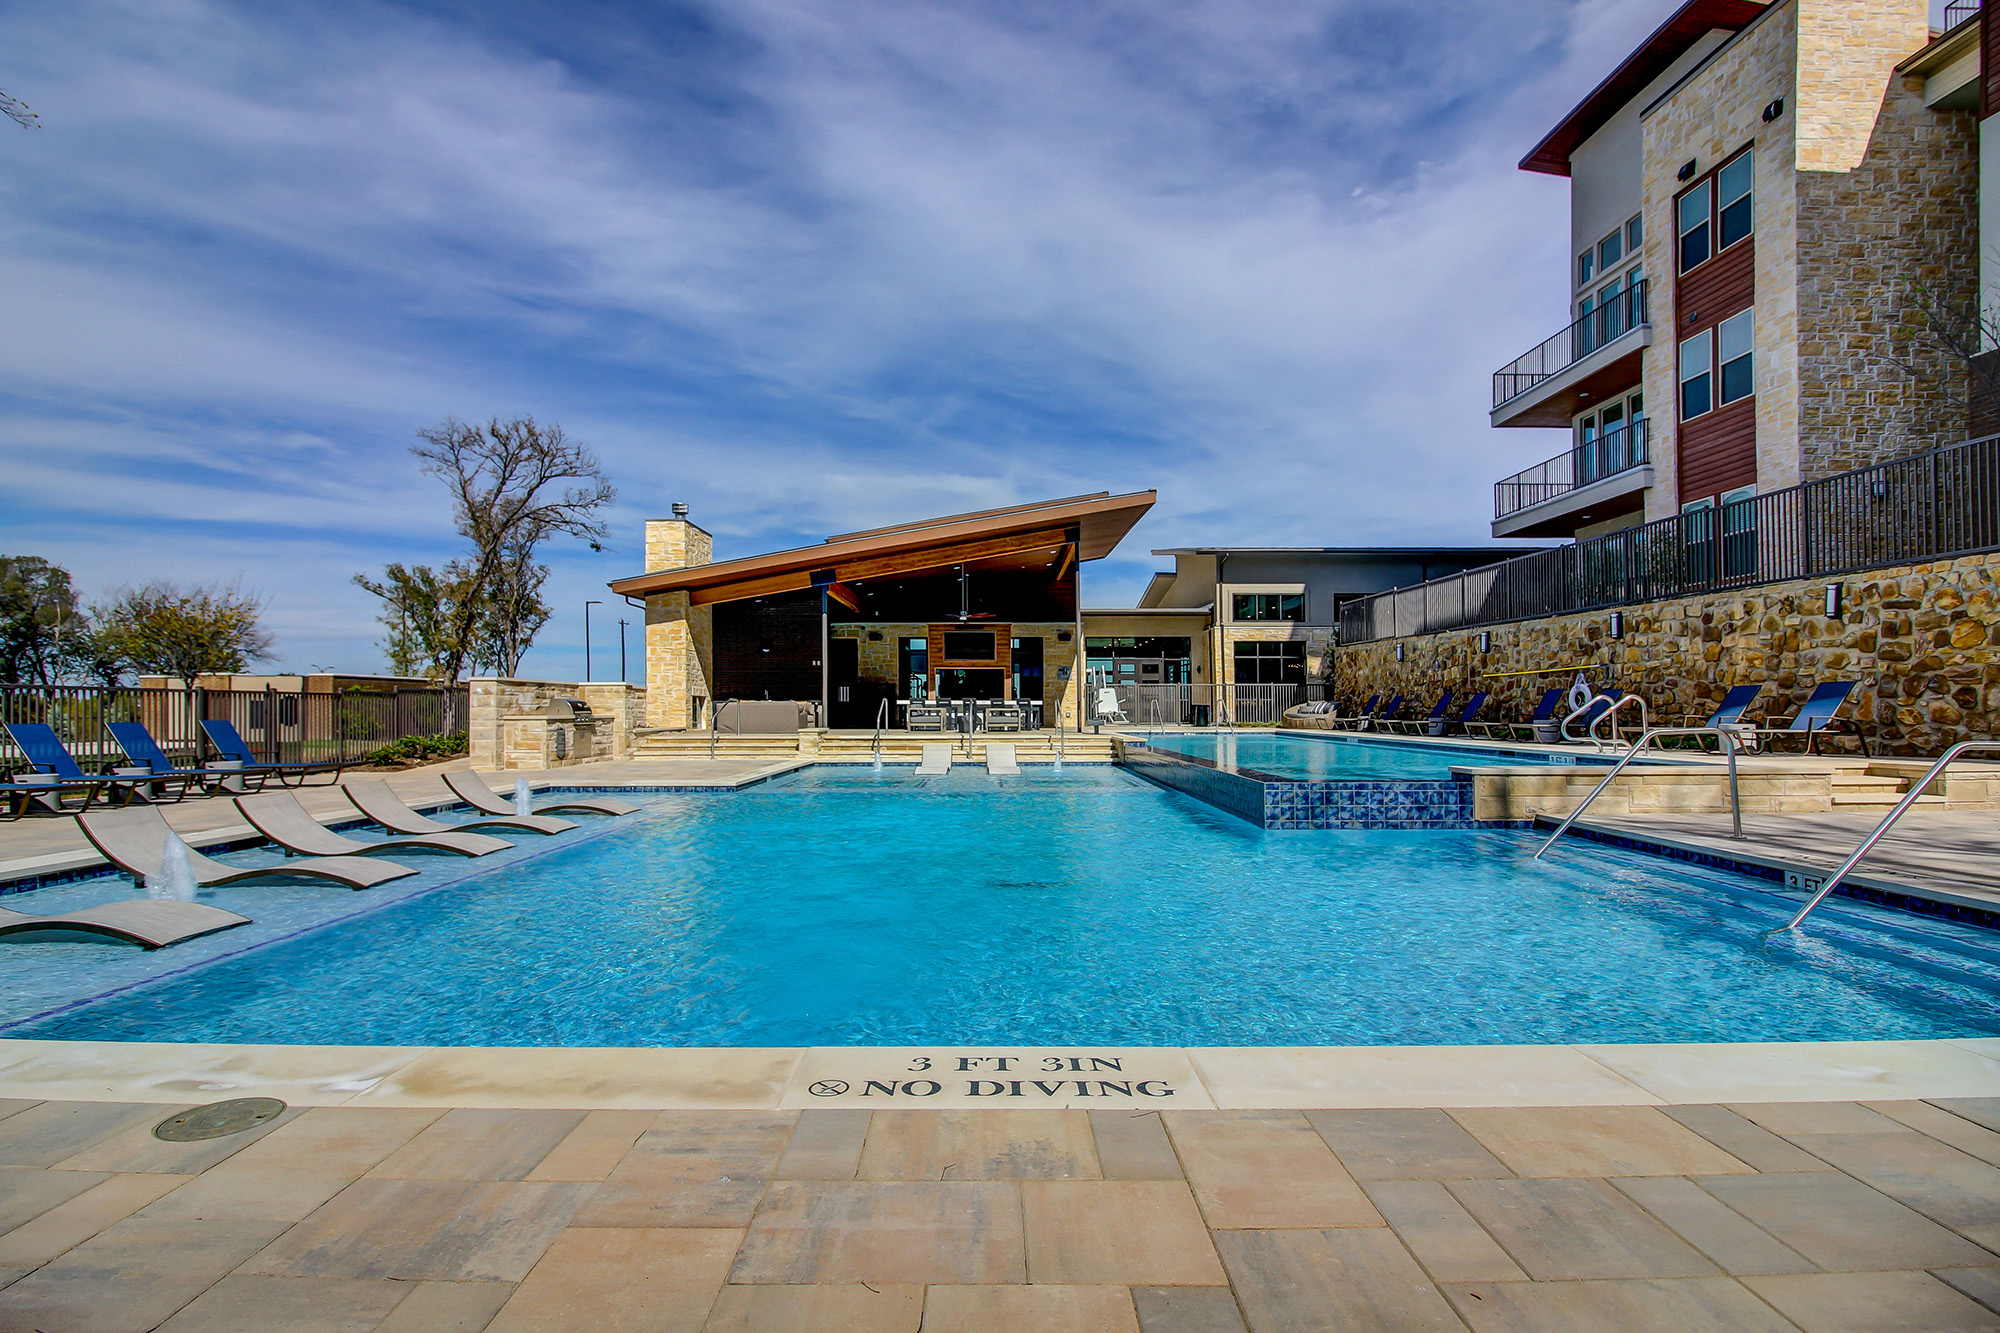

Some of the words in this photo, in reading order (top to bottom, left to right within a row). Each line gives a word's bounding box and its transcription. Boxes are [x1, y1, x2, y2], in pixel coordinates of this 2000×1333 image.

[1804, 877, 1821, 891] FT
[907, 1057, 932, 1072] 3
[954, 1057, 1020, 1072] FT
[1041, 1057, 1123, 1072] 3IN
[858, 1080, 942, 1097] NO
[964, 1080, 1177, 1097] DIVING
